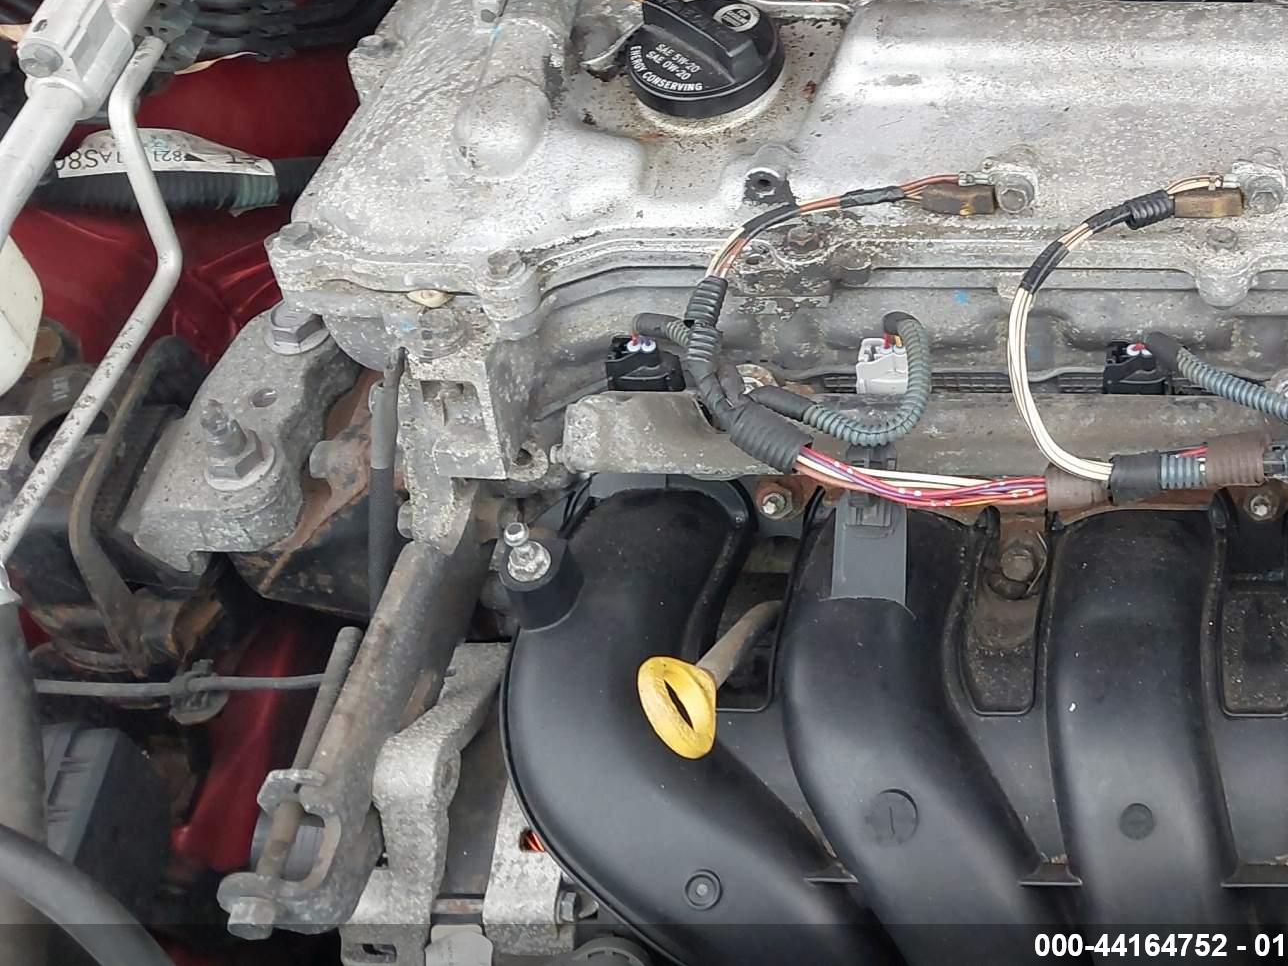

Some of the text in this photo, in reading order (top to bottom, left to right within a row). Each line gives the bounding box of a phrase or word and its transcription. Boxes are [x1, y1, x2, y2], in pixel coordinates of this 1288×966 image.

[630, 45, 703, 91] ENERGY CONSERVING
[646, 51, 691, 80] SAE 0W-20
[656, 44, 701, 72] SAE 5W-20
